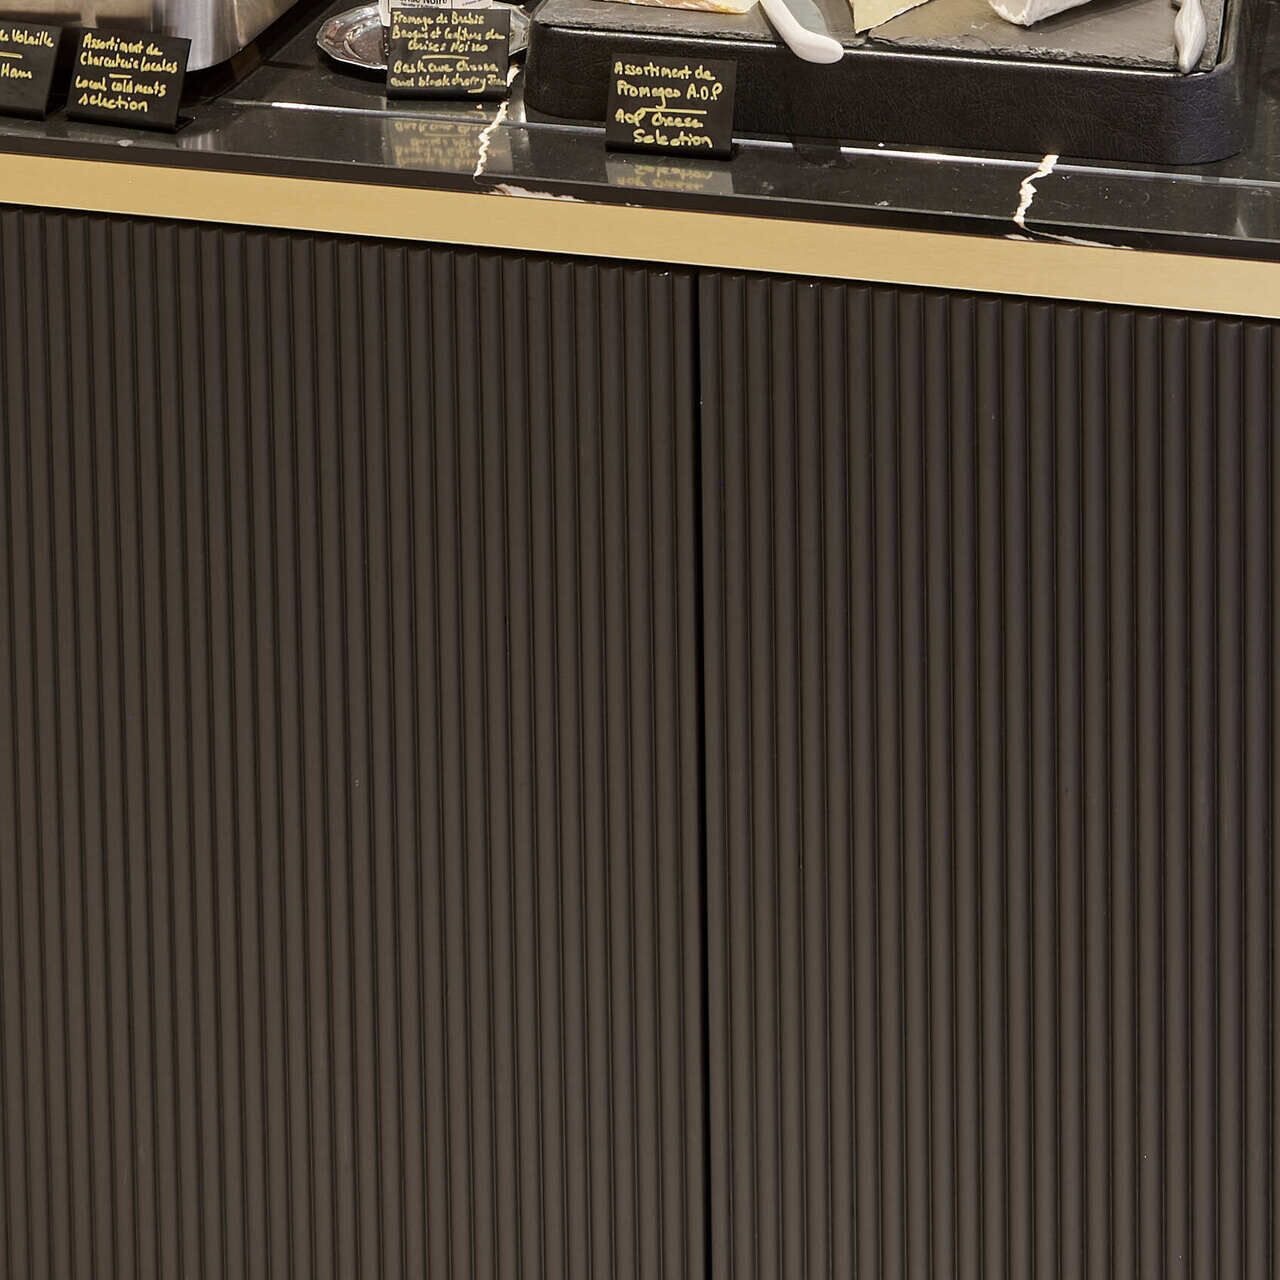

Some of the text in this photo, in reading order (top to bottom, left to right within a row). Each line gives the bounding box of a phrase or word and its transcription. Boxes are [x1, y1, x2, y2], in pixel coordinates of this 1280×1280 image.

[82, 32, 163, 56] Assortiment de
[0, 62, 33, 79] Ham
[614, 61, 716, 81] Assortiment de
[616, 79, 681, 108] Fromages
